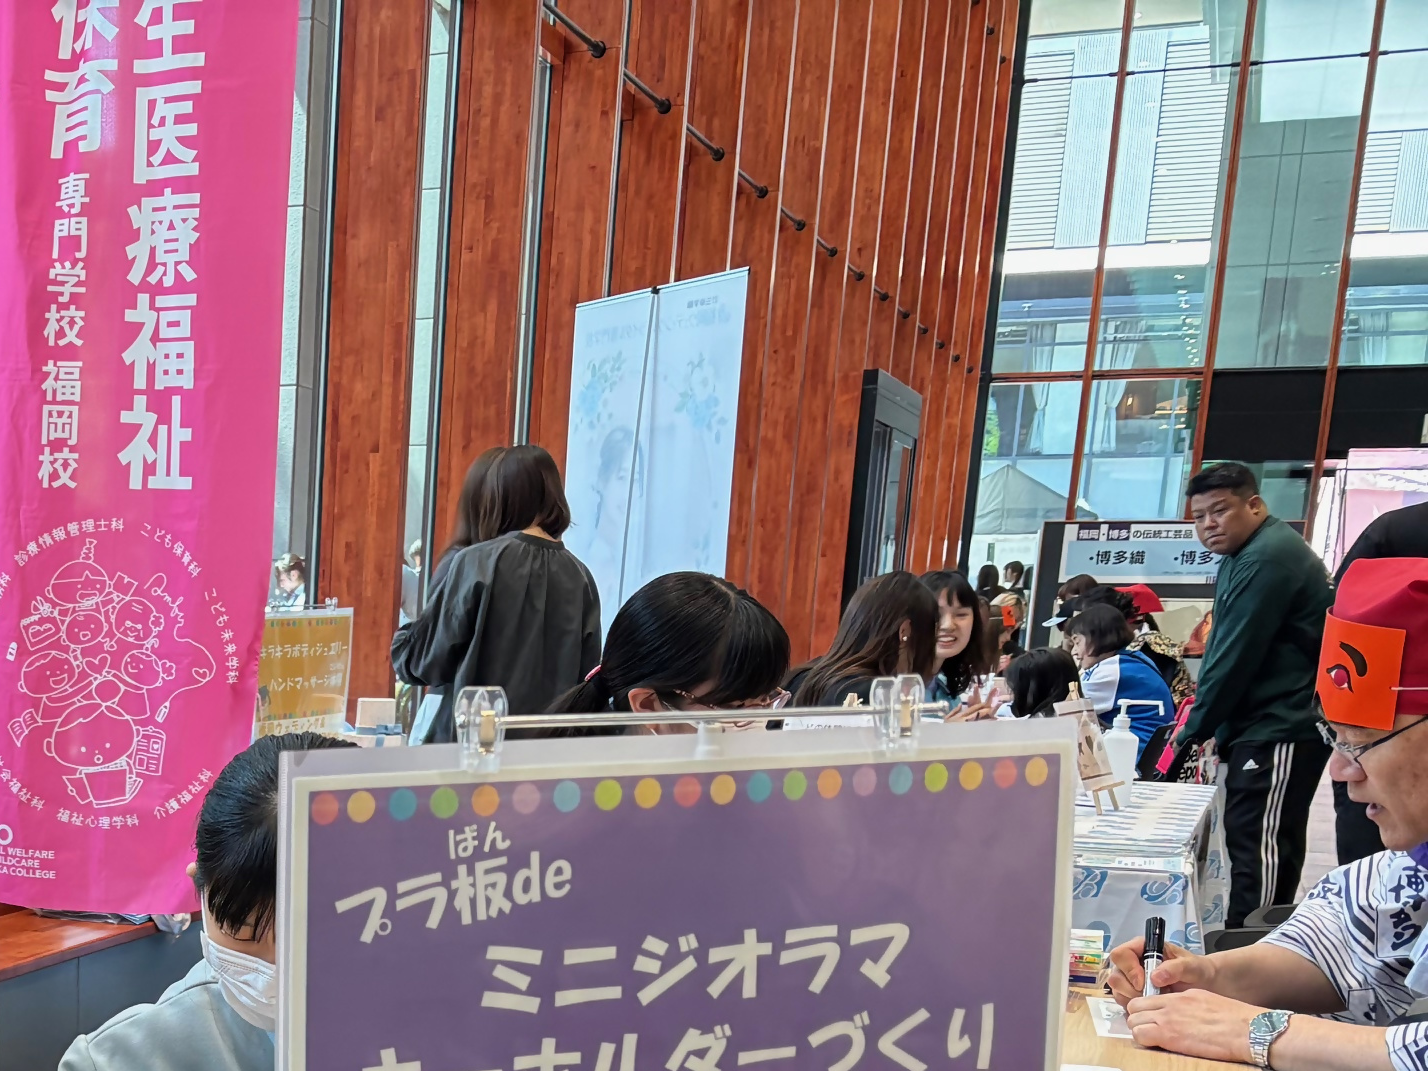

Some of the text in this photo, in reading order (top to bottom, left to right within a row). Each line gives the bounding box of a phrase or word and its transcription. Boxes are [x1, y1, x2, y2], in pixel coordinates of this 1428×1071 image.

[43, 171, 90, 348] 専門学校
[37, 359, 84, 489] 福岡校
[56, 807, 140, 830] 福祉心理学科
[153, 768, 215, 820] 介護福祉科
[7, 846, 56, 860] WELFARE
[448, 821, 511, 859] ばん
[9, 866, 57, 880] COLLEGE
[334, 851, 574, 945] プラ板de
[480, 921, 911, 1015] ミニジオラマ
